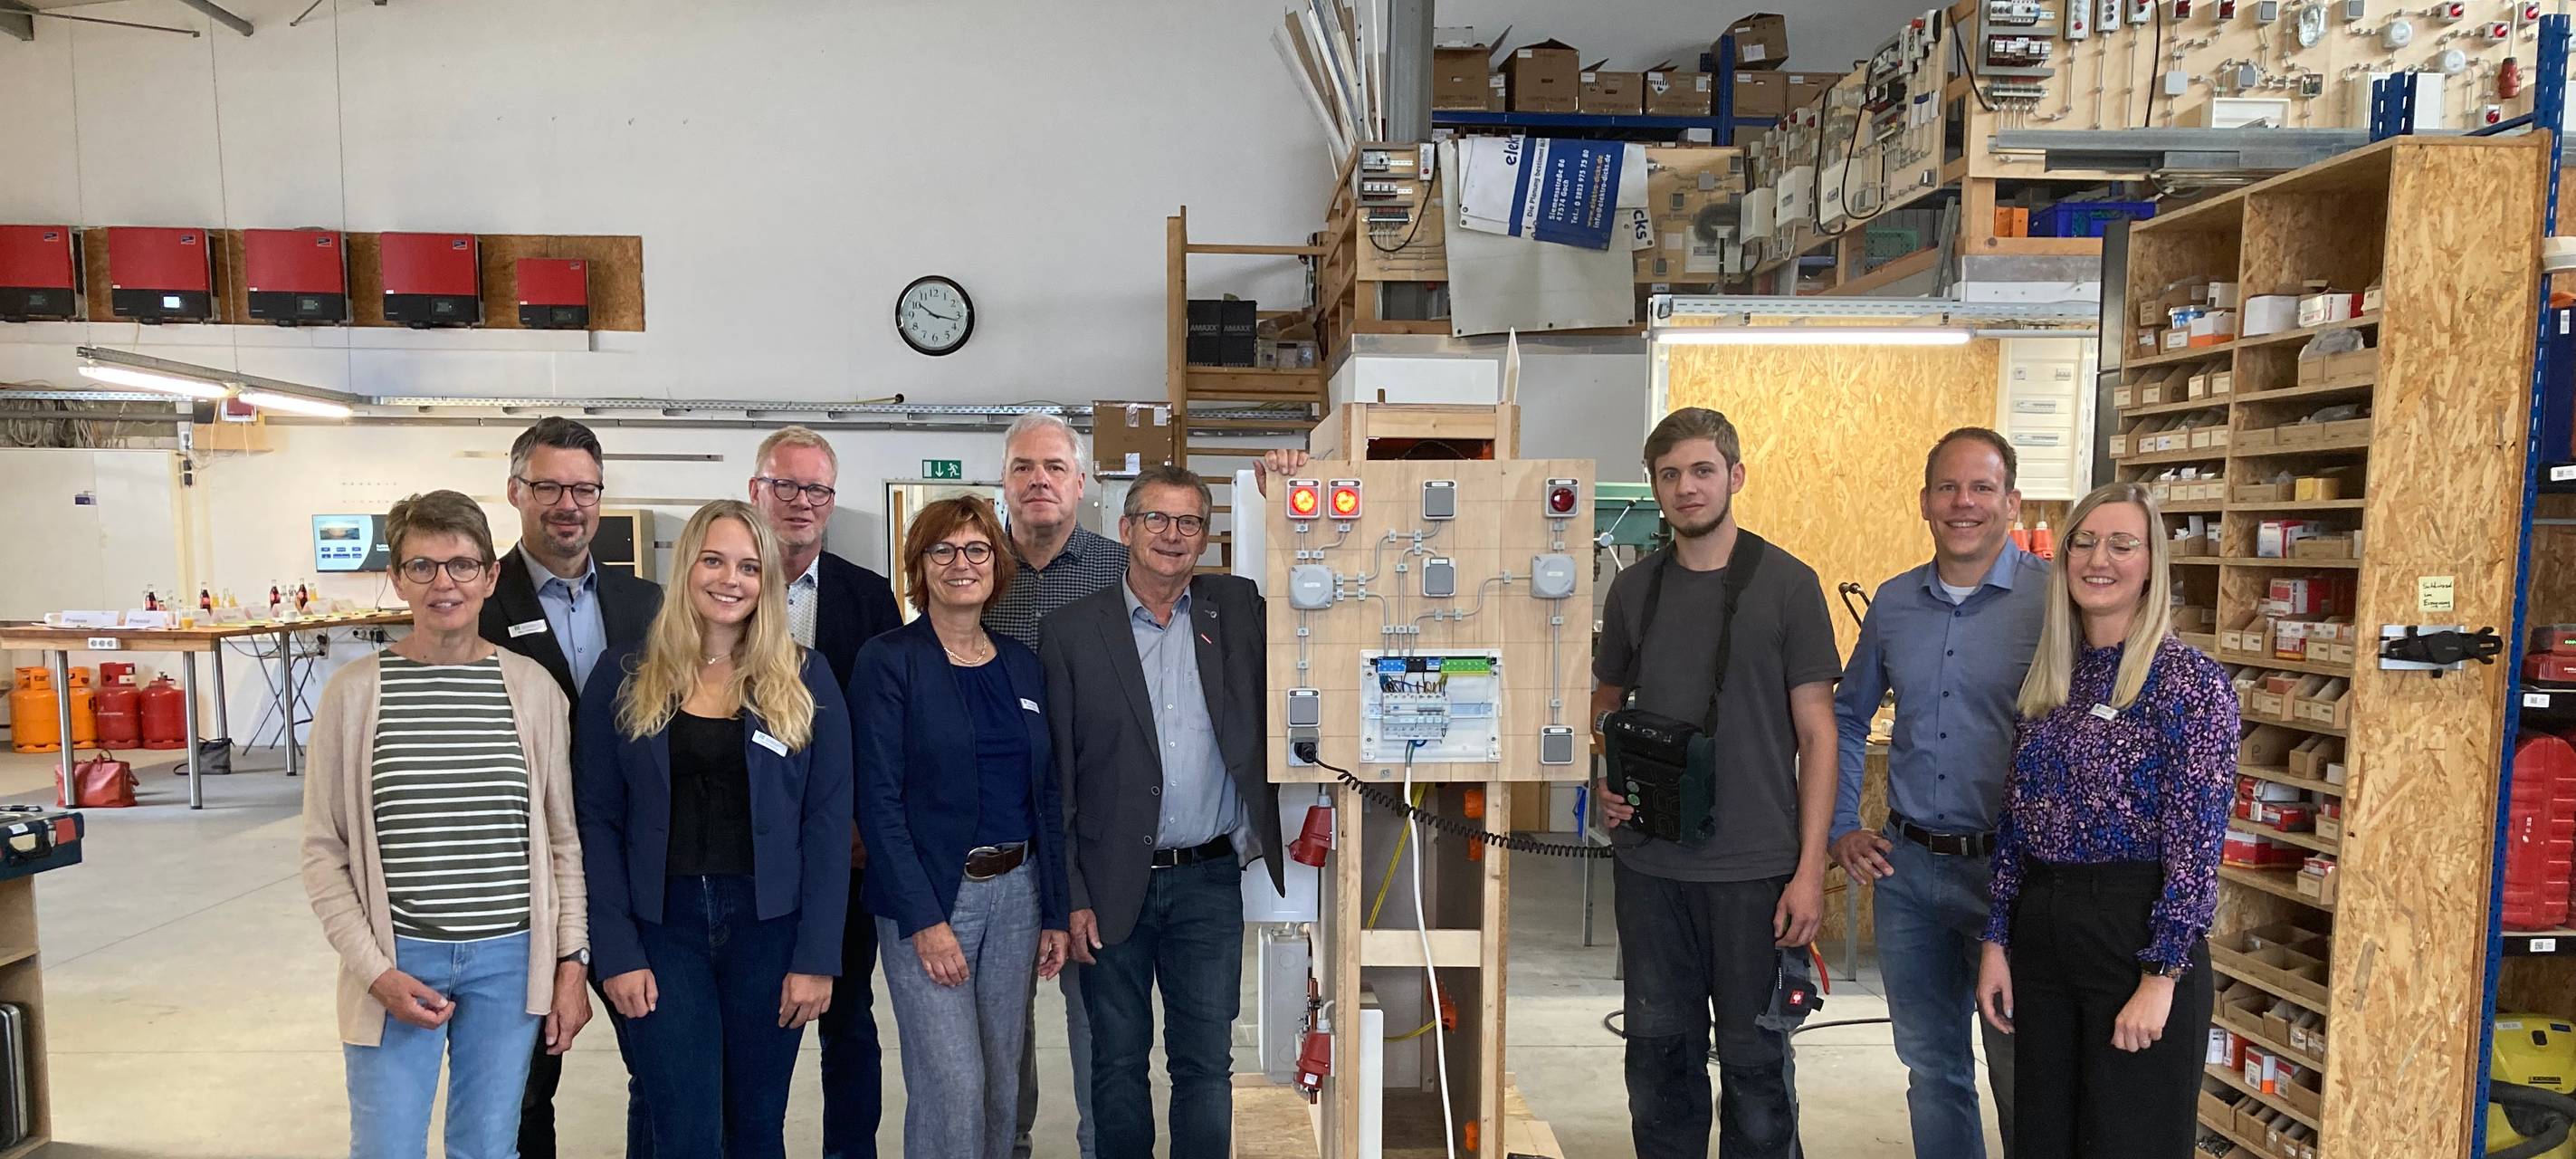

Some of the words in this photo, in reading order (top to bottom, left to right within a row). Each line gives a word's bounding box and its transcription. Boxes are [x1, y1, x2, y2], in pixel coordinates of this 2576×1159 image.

[1580, 159, 1588, 168] 75
[1578, 170, 1586, 183] 975
[1530, 178, 1541, 205] Planung
[1561, 179, 1569, 197] Goch
[1576, 184, 1584, 199] 2823
[1593, 153, 1612, 229] info@elektro-dicks.de
[1549, 168, 1564, 220] Siemensstraße
[1527, 205, 1535, 217] Die
[1557, 198, 1567, 222] 47574
[920, 292, 928, 301] 11
[929, 289, 940, 298] 12
[943, 292, 948, 301] 1
[911, 302, 921, 310] 10
[950, 300, 957, 308] 2
[908, 311, 915, 320] 9
[957, 311, 962, 320] 3
[912, 322, 919, 330] 8
[951, 322, 958, 330] 4
[1190, 323, 1217, 332] AMAXX
[1224, 324, 1251, 332] AMAXX
[921, 330, 928, 340] 7
[931, 333, 939, 342] 6
[945, 331, 950, 341] 5
